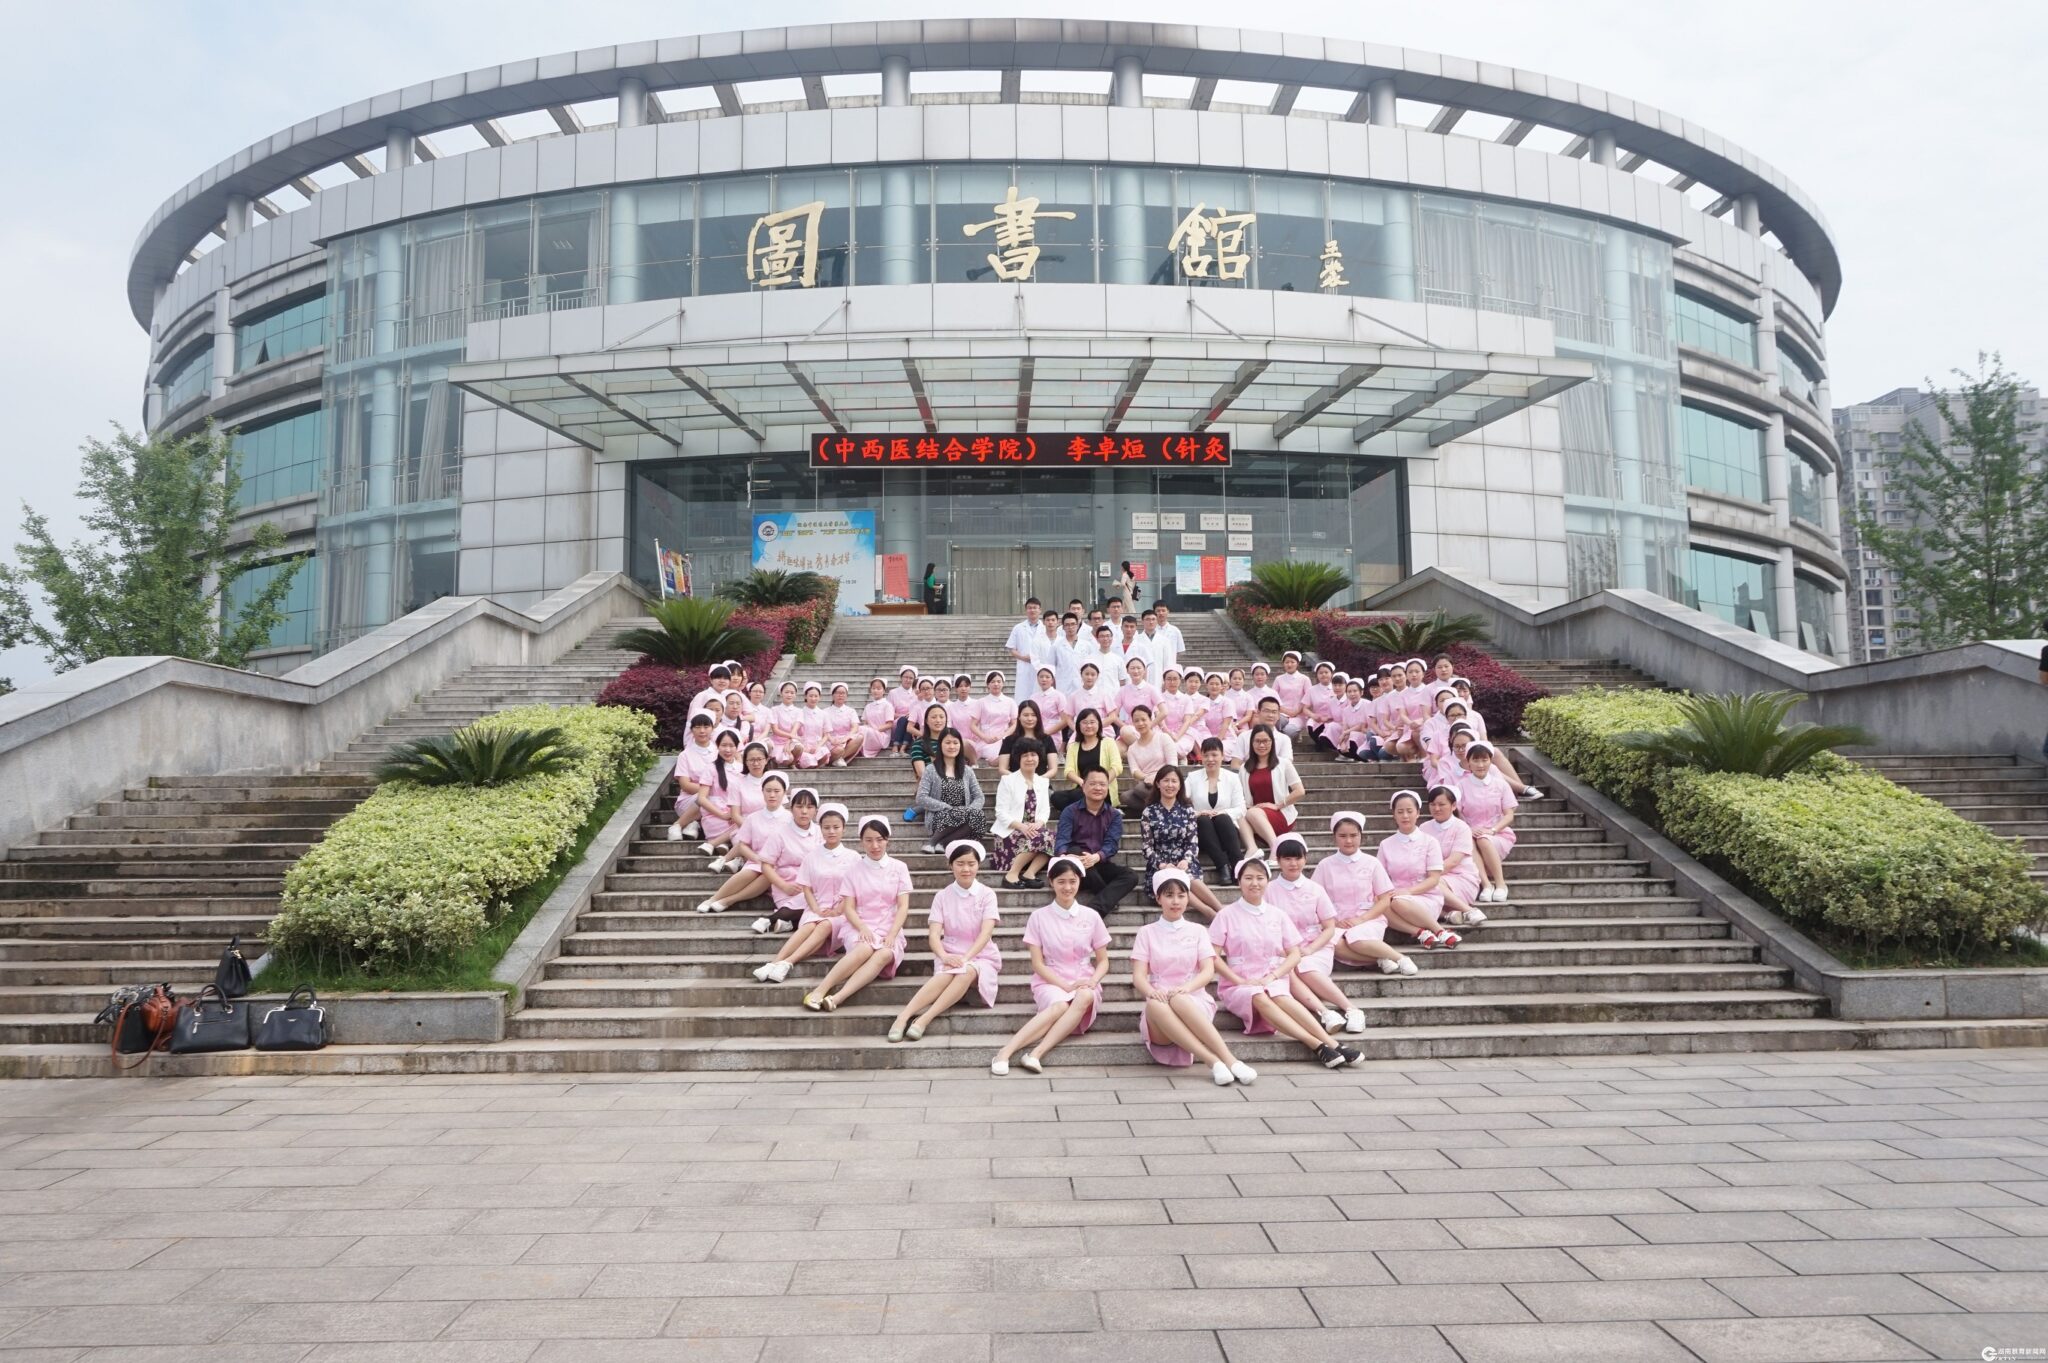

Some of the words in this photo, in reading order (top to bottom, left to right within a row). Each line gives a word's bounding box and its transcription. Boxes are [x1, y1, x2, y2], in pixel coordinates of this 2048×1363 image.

[747, 186, 1256, 288] 圖書館
[818, 436, 1037, 463] （中西医结合学院）
